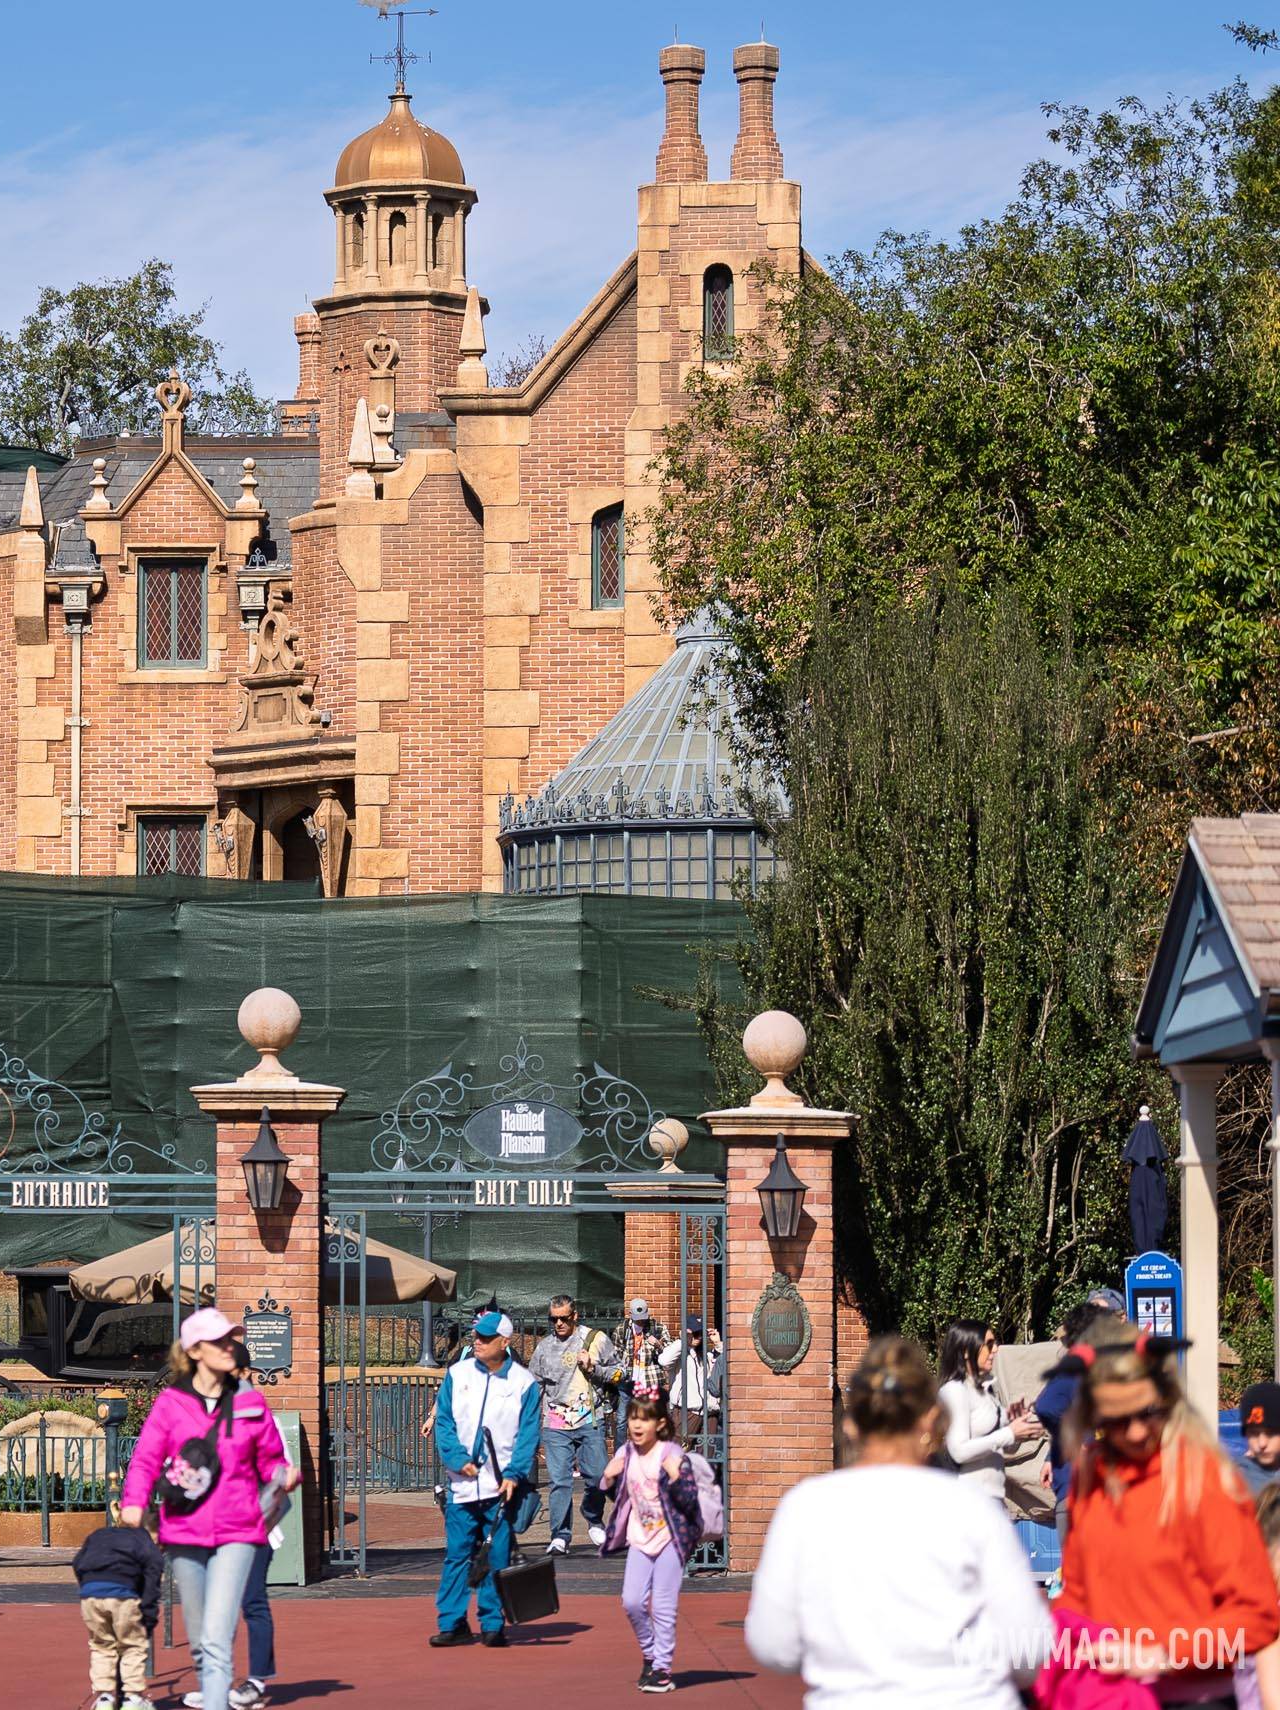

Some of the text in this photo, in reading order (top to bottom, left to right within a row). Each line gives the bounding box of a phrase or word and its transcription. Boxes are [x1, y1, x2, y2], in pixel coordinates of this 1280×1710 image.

[500, 1108, 546, 1132] Haunted
[498, 1132, 546, 1158] Mansion
[11, 1180, 109, 1207] ENTRANCE
[475, 1179, 574, 1206] EXIT ONLY
